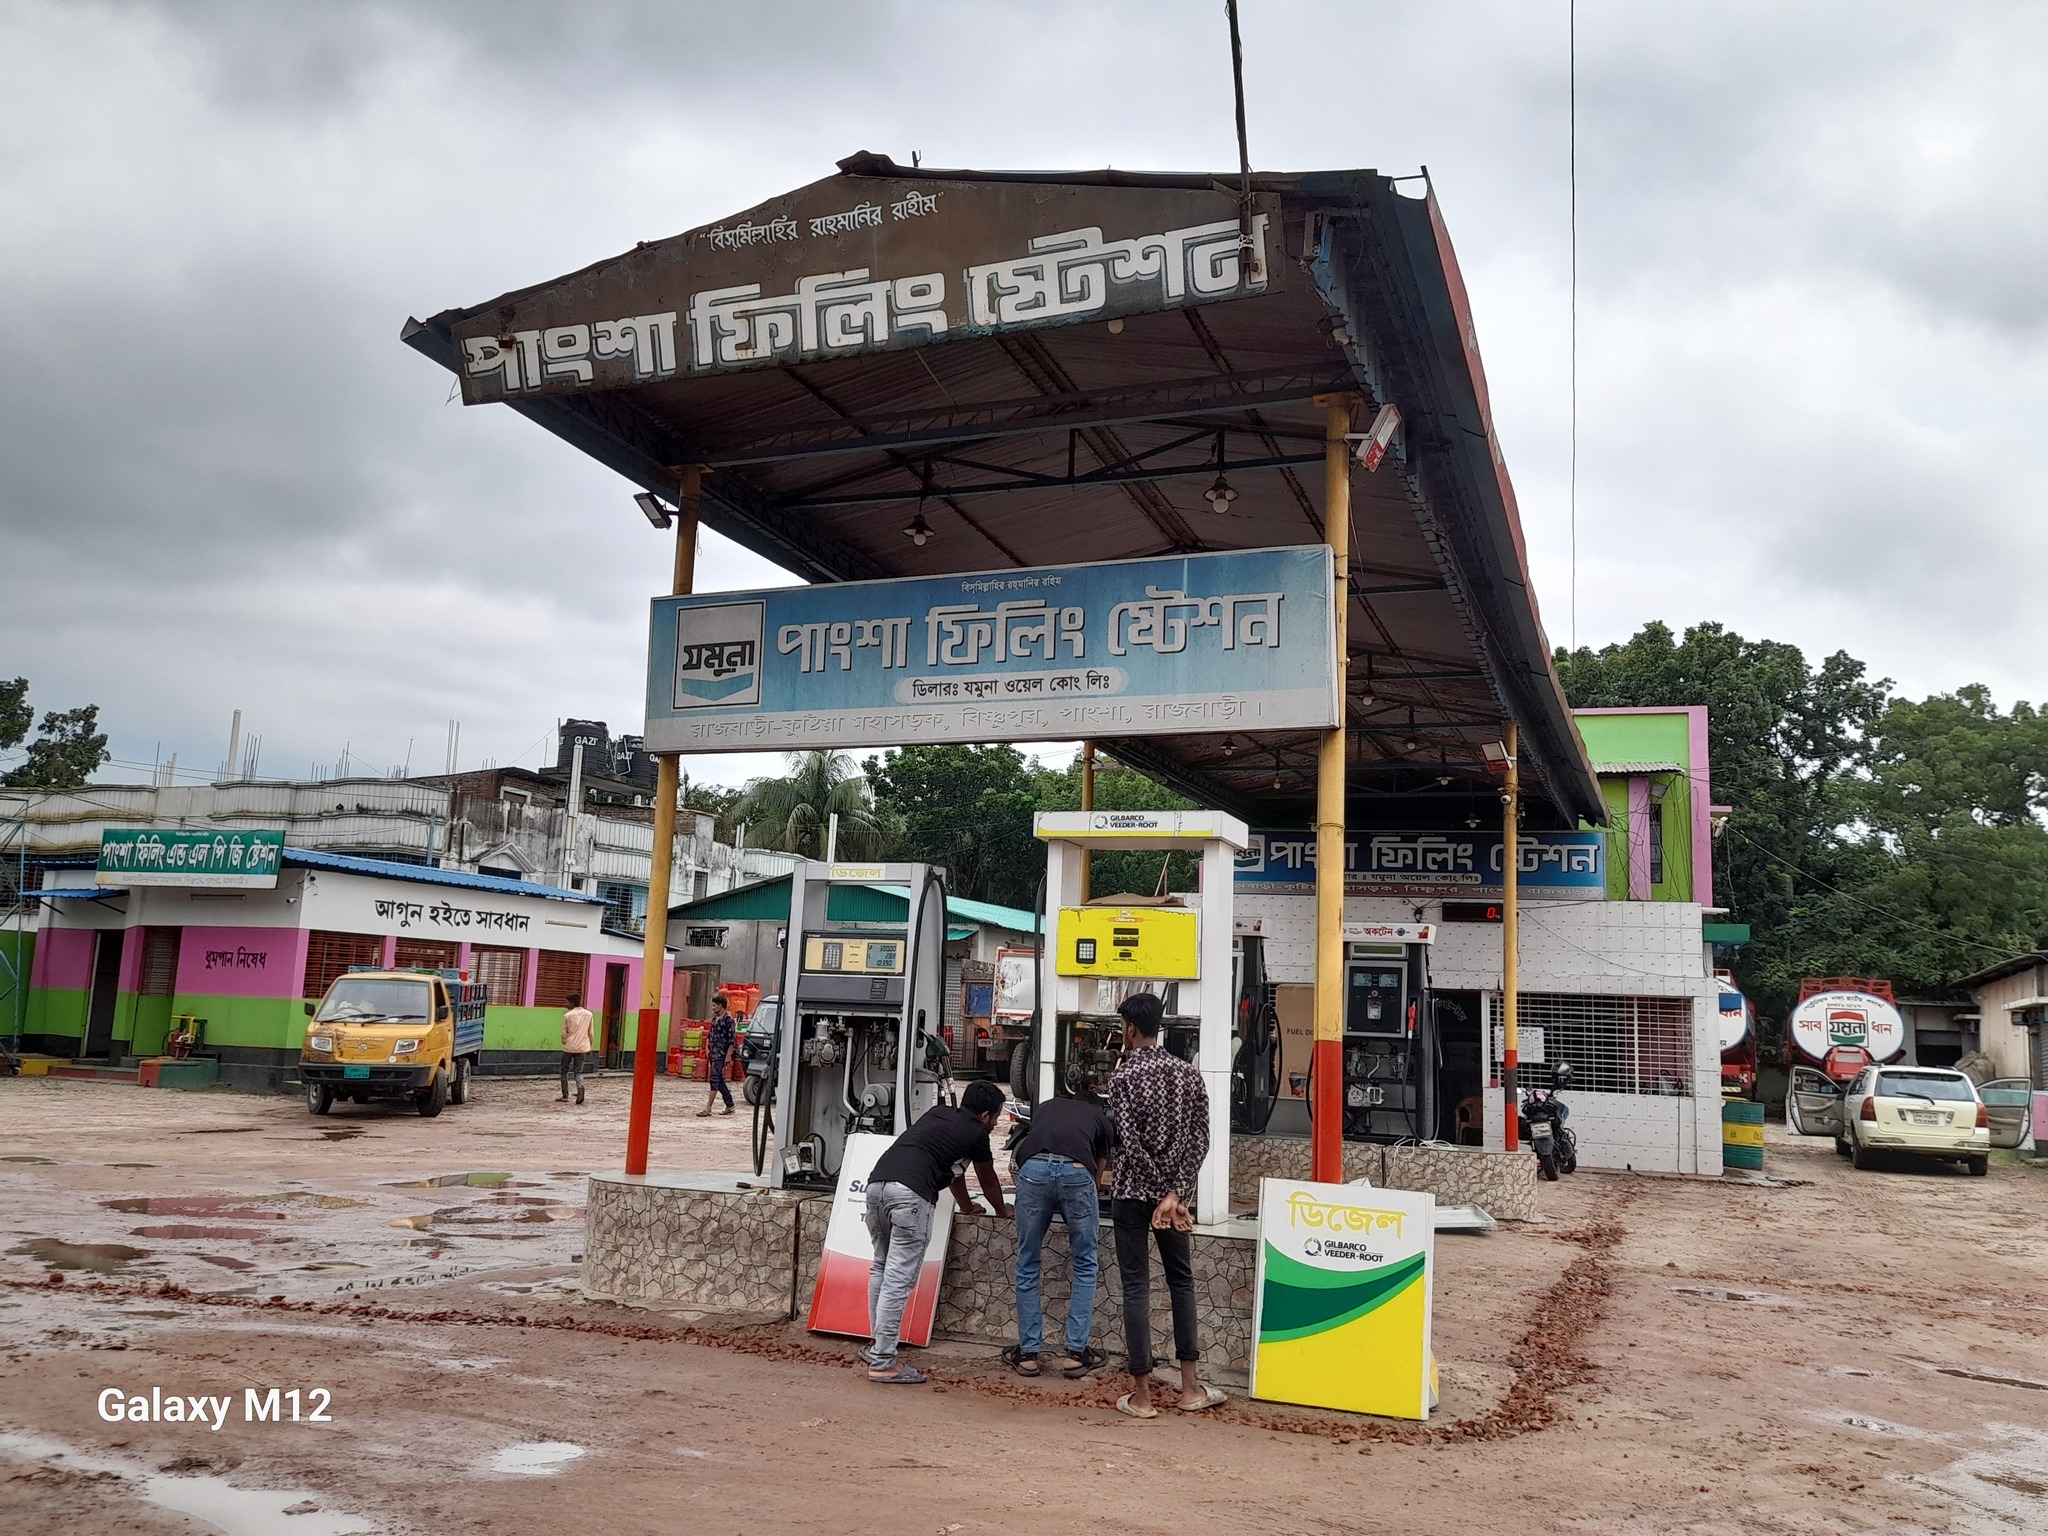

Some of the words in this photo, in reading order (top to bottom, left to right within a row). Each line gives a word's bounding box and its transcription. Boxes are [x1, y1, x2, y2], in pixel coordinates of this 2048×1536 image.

[463, 310, 678, 392] পাংশা
[686, 268, 950, 372] ফিলিং
[778, 617, 912, 674] পাংশা
[925, 598, 1086, 667] ফিলিং
[682, 640, 756, 677] যমুনা
[964, 679, 999, 699] যমুনা
[1004, 677, 1044, 693] ওয়েল
[1050, 674, 1081, 692] কোং
[1110, 814, 1145, 822] GILBARCO
[102, 840, 134, 869] পাংশা
[134, 834, 166, 870] ফিলিং
[189, 843, 211, 868] এল
[210, 835, 227, 868] পি
[227, 835, 246, 869] জি
[1369, 836, 1474, 871] ফিলিং
[374, 899, 424, 928] আগুন
[429, 900, 473, 927] হইতে
[475, 910, 531, 933] সাবধান
[236, 946, 268, 970] নিষেধ
[1286, 1027, 1304, 1036] FUEL
[1799, 1020, 1822, 1032] সাব
[1829, 1021, 1867, 1036] যমুনা
[1871, 1021, 1893, 1035] ধান
[848, 1180, 868, 1194] Su
[1285, 1191, 1408, 1240] ডিজেল
[1323, 1240, 1368, 1252] GILBARCO
[1323, 1249, 1385, 1264] VEEDER-ROOT
